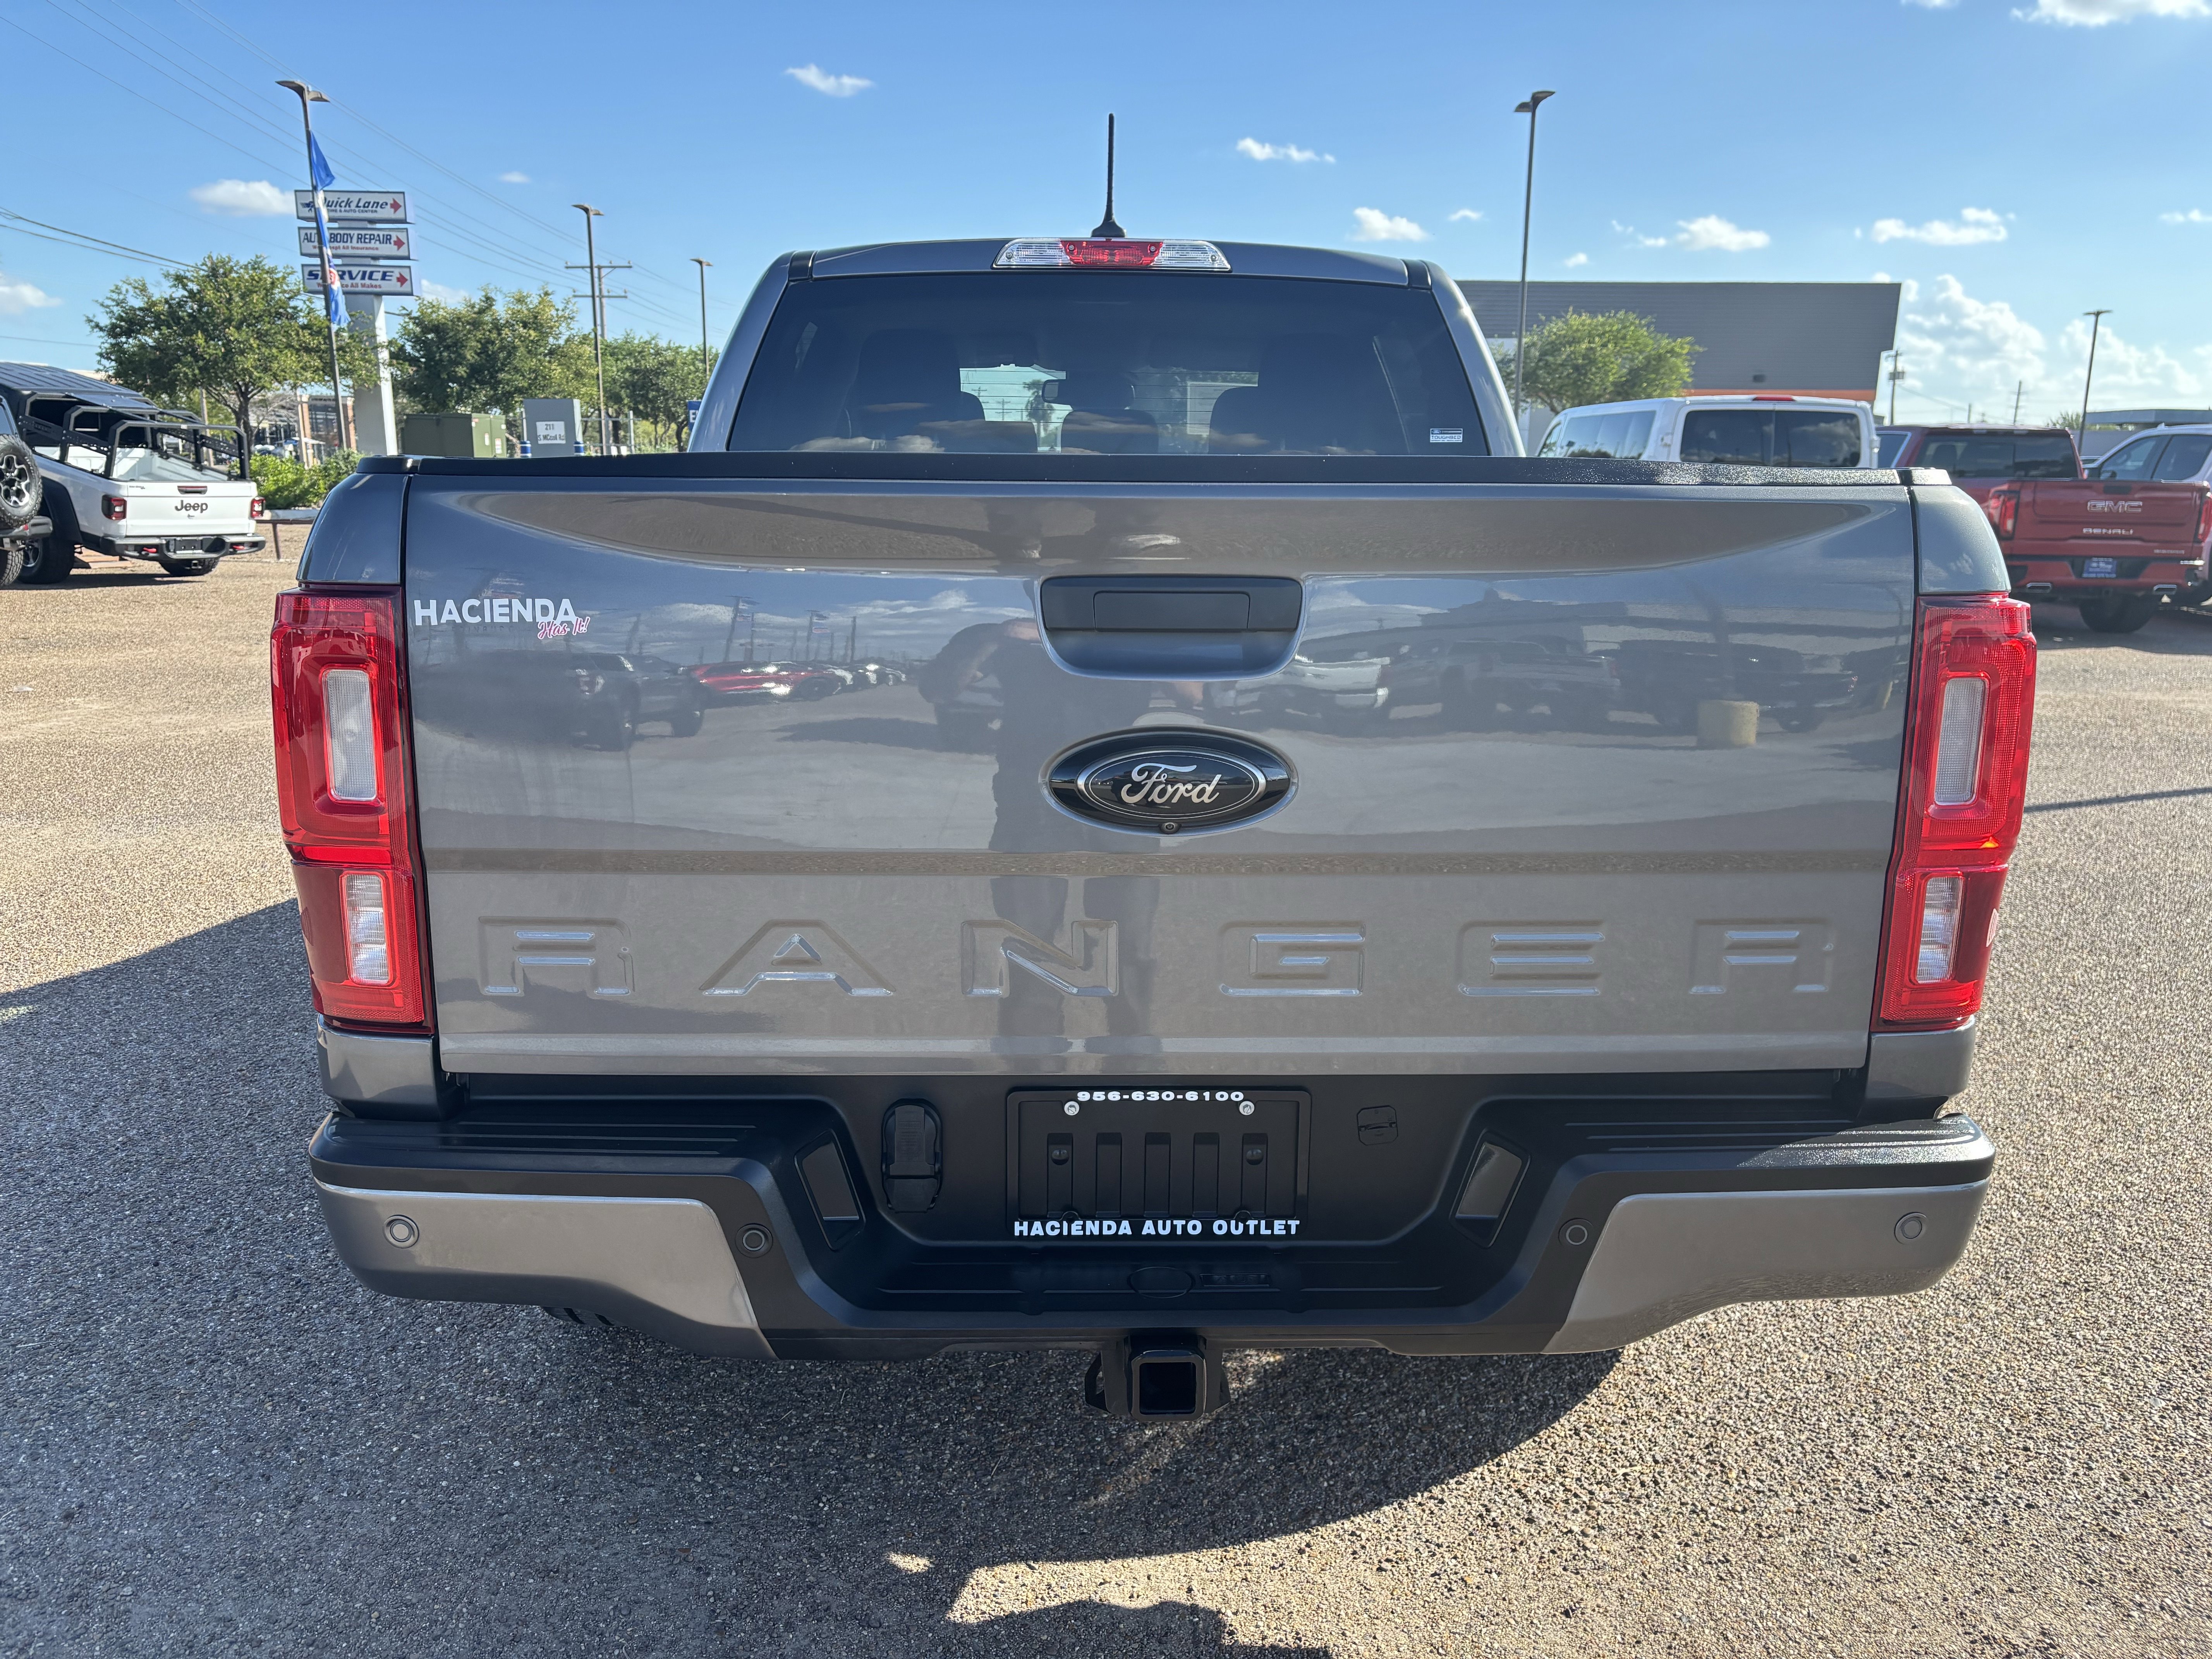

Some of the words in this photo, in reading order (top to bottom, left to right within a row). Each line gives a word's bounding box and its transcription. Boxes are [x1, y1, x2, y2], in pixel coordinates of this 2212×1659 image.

[324, 196, 353, 208] uick
[355, 198, 388, 209] Lane
[302, 232, 317, 243] AU
[330, 233, 355, 243] BODY
[356, 234, 392, 244] REPAIR
[306, 270, 394, 281] SRVICE
[175, 500, 208, 513] Jeep
[2087, 500, 2143, 513] GMC
[414, 598, 577, 625] HACIENDA
[538, 620, 570, 639] Has
[572, 617, 591, 635] It!
[1121, 763, 1222, 804] Ford
[479, 916, 1833, 996] RANGER
[1077, 1091, 1244, 1102] 956-630-6100
[1014, 1221, 1132, 1236] HACIENDA
[1142, 1220, 1202, 1235] AUTO
[1212, 1220, 1300, 1235] OUTLET
